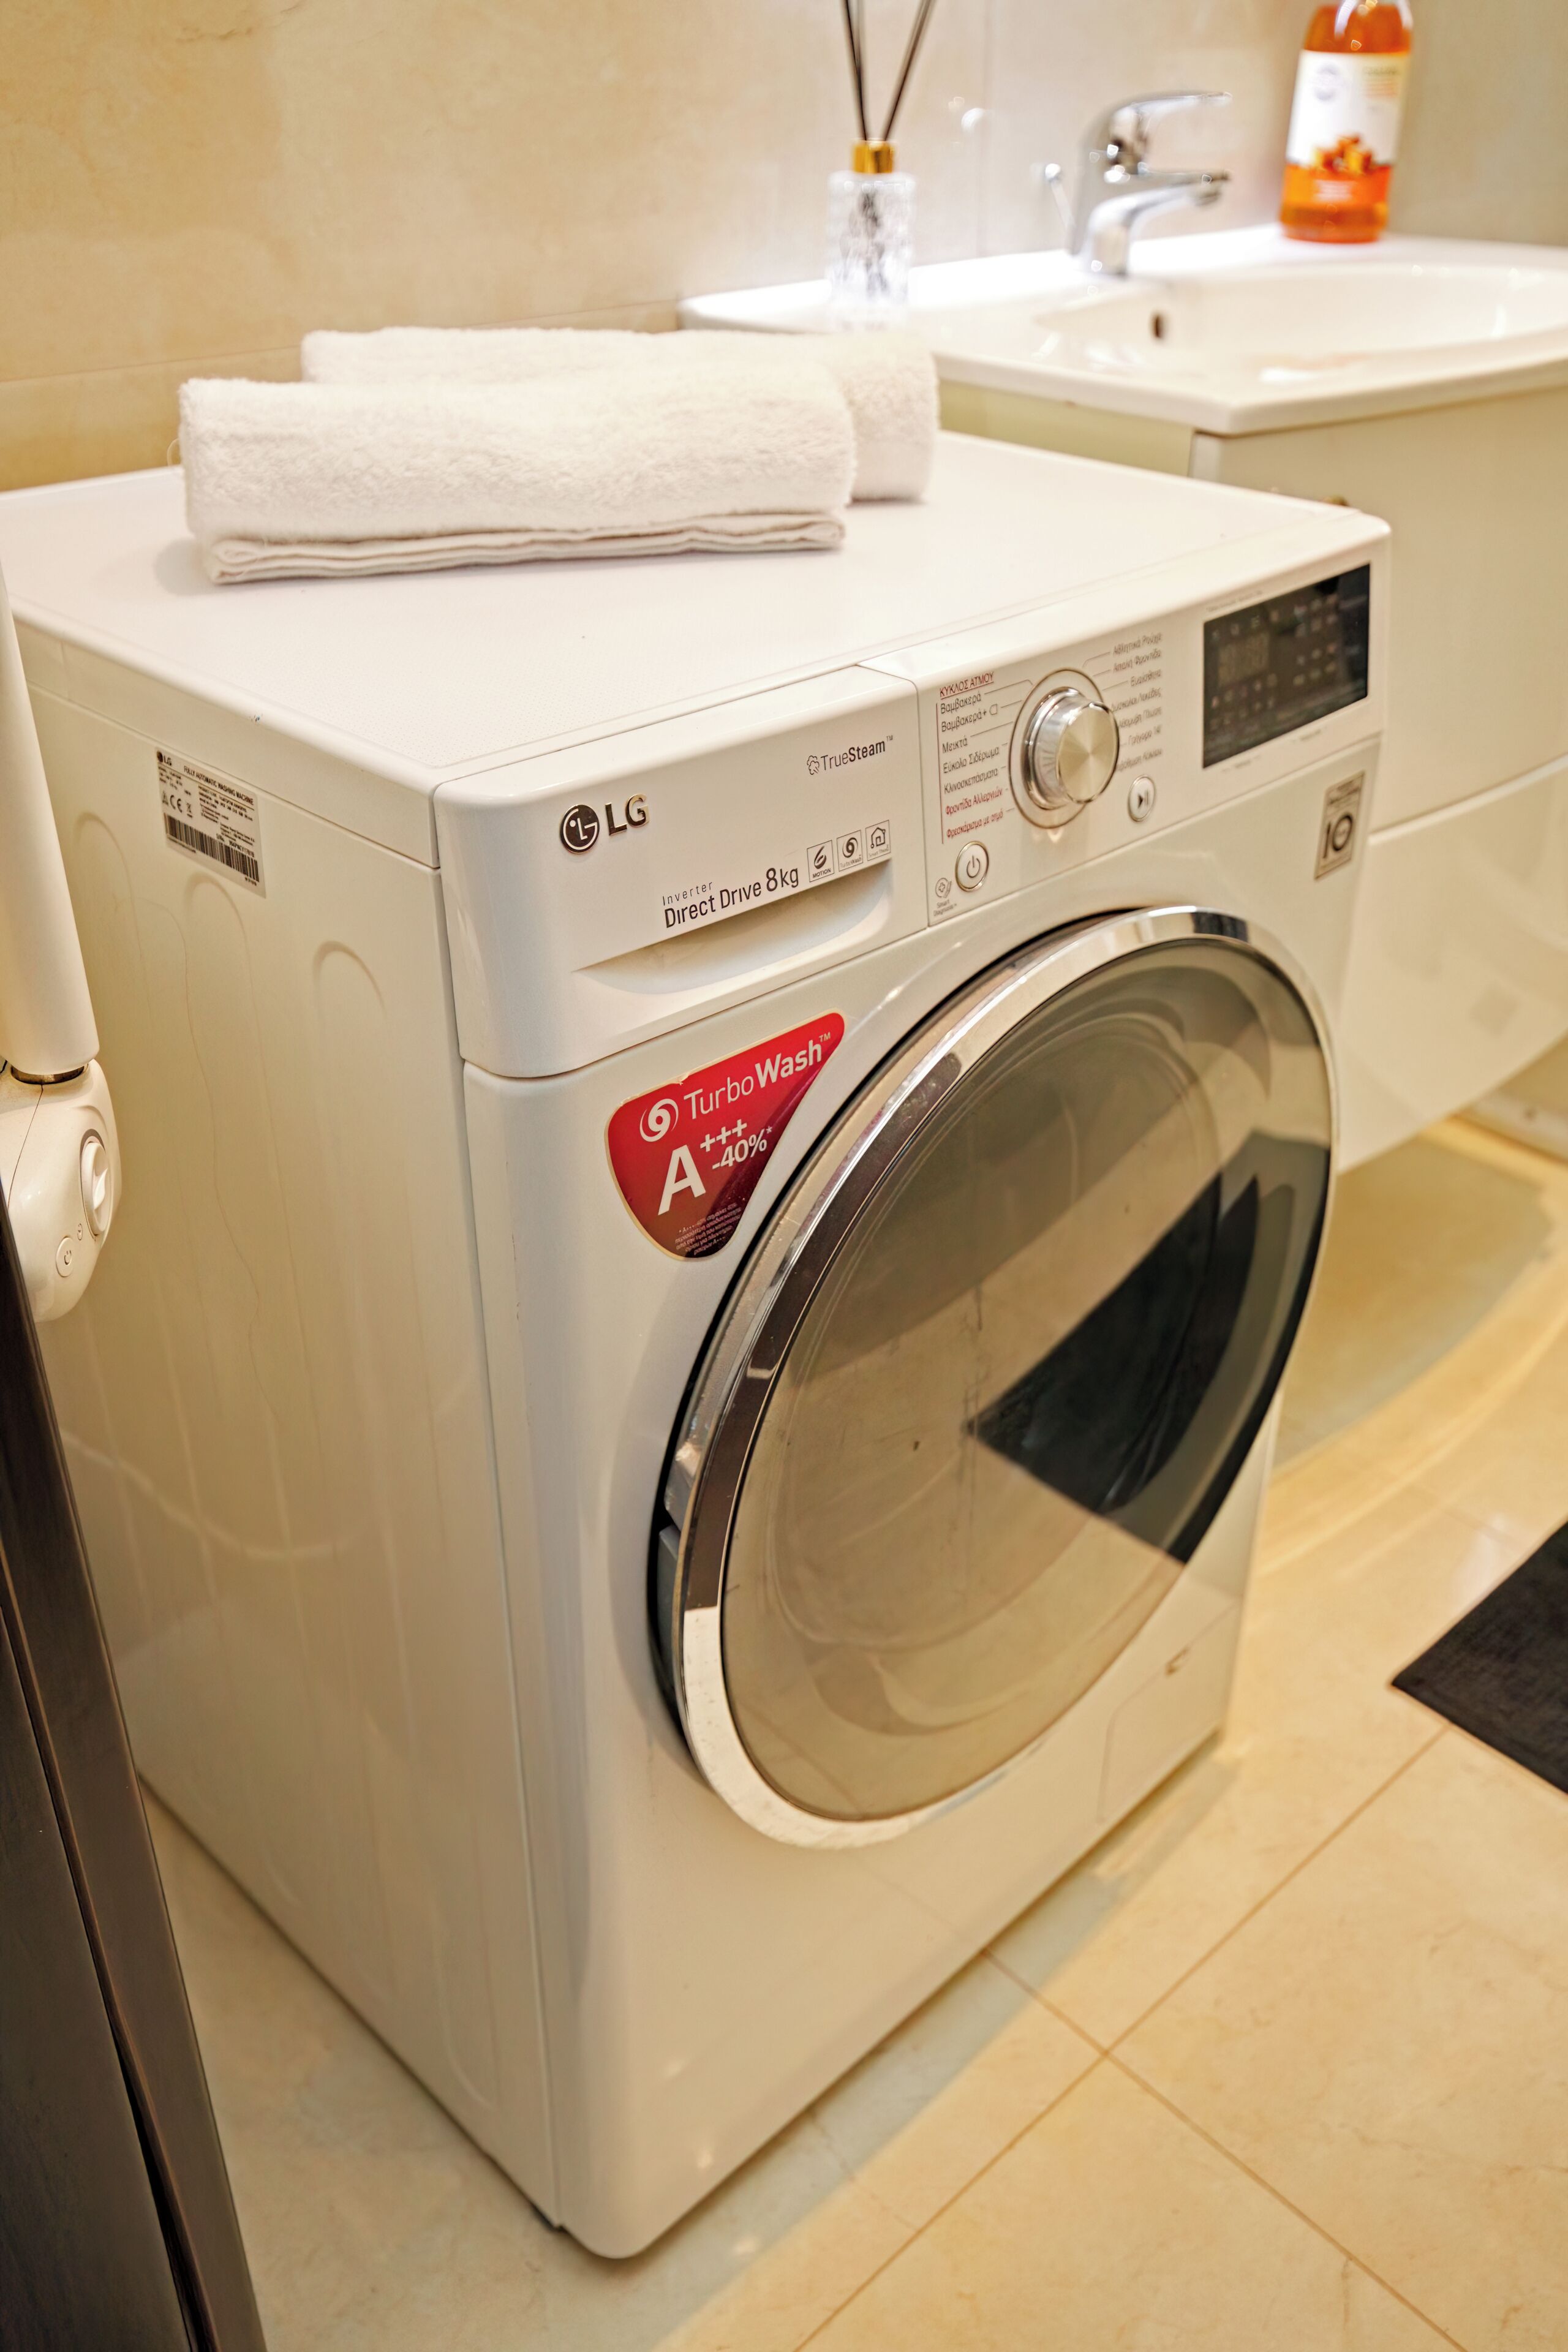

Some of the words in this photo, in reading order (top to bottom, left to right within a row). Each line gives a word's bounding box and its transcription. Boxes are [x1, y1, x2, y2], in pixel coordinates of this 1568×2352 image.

[940, 679, 968, 697] ΚΥΚΛΟΣ
[970, 671, 994, 688] ΑΤΜΟΥ
[940, 691, 981, 714] Βαμβακερά
[942, 735, 968, 753] Μεικτά
[943, 758, 967, 774] Εύκολο
[968, 747, 1000, 764] Σιδέρωμα
[944, 768, 998, 794] Κλινοσκεπάσματα
[605, 793, 650, 837] LG
[946, 797, 971, 815] Φροντίδα
[812, 868, 832, 878] MOTION
[662, 881, 713, 906] Inverter
[665, 895, 716, 929] Direct
[720, 882, 761, 909] Drive
